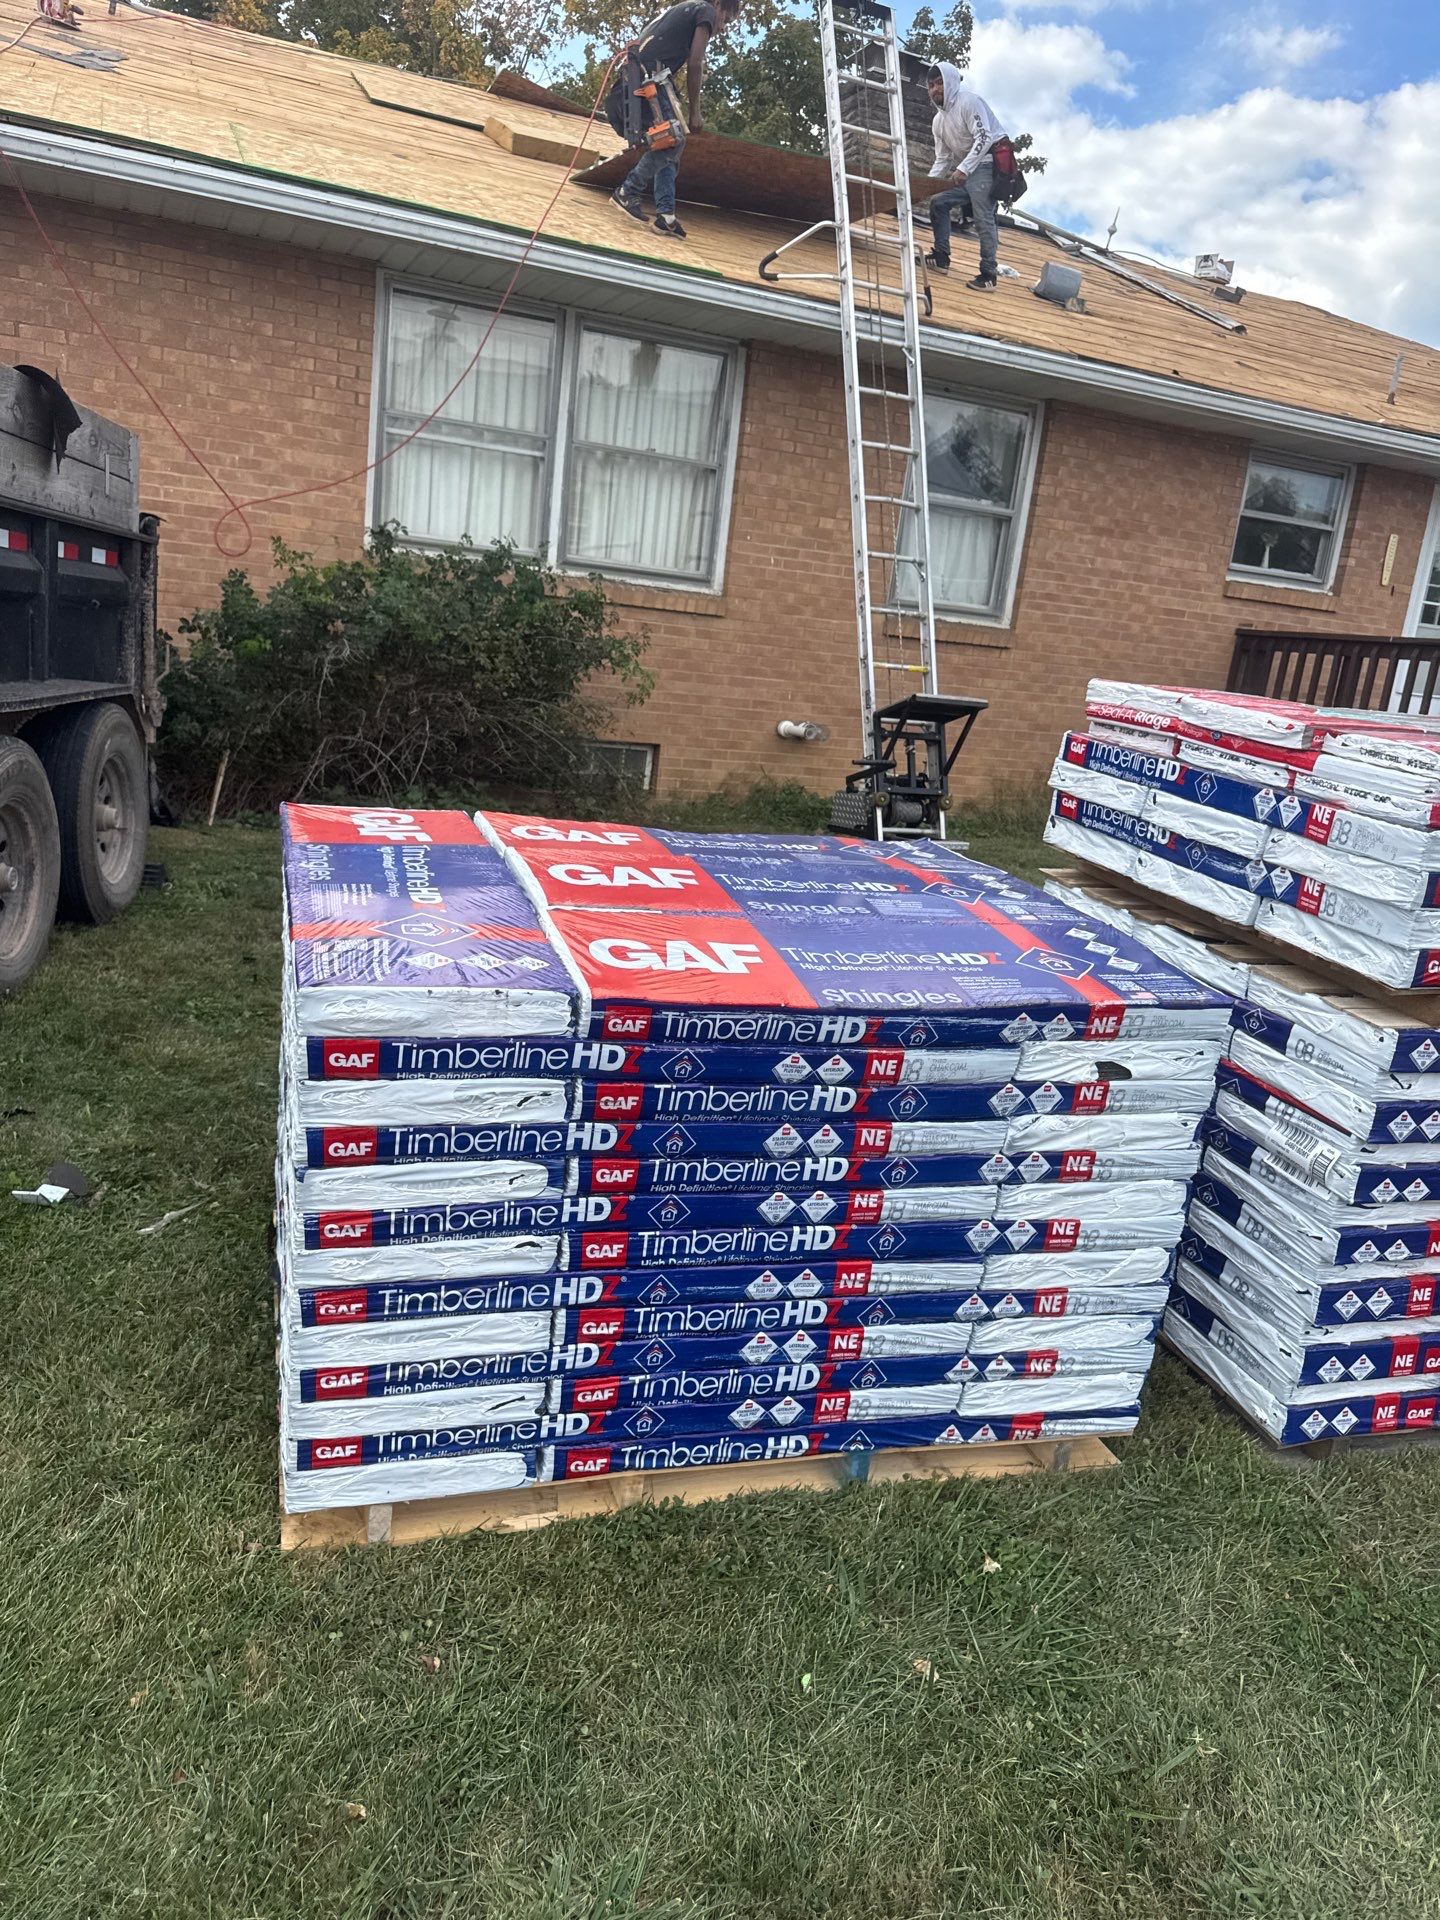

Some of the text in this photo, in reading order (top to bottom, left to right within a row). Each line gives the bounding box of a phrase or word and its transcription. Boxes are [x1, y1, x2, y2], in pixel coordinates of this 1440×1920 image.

[1070, 740, 1088, 757] GAF
[1359, 747, 1401, 764] CHARCOAL
[1344, 785, 1370, 799] RIDGE
[1062, 797, 1077, 810] GAF
[1312, 805, 1332, 825] NE
[350, 812, 433, 842] GAF
[1330, 817, 1353, 846] 08
[511, 824, 641, 846] GAF
[547, 863, 699, 890] GAF
[1304, 878, 1322, 897] NE
[747, 901, 871, 915] Shingles
[589, 938, 763, 974] GAF
[800, 962, 829, 972] High
[832, 964, 888, 972] Definition
[822, 988, 962, 1006] Shingles
[607, 1019, 646, 1033] GAF
[1091, 1016, 1117, 1034] NE
[1295, 1038, 1315, 1063] 08
[329, 1052, 375, 1068] GAF
[871, 1059, 898, 1076] NE
[1079, 1085, 1104, 1101] NE
[600, 1096, 639, 1110] GAF
[860, 1130, 886, 1147] NE
[328, 1142, 373, 1157] GAF
[1066, 1156, 1090, 1171] NE
[596, 1168, 635, 1182] GAF
[650, 1184, 675, 1192] High
[679, 1184, 729, 1192] Definition
[854, 1193, 878, 1209] NE
[324, 1224, 368, 1239] GAF
[1052, 1221, 1075, 1236] NE
[1244, 1217, 1264, 1240] 08
[585, 1245, 624, 1259] GAF
[839, 1273, 867, 1289] NE
[1413, 1288, 1432, 1302] NE
[320, 1303, 363, 1316] GAF
[1039, 1296, 1062, 1313] NE
[582, 1322, 618, 1335] GAF
[834, 1334, 859, 1350] NE
[1030, 1358, 1052, 1373] NE
[1394, 1354, 1414, 1368] NE
[320, 1374, 364, 1388] GAF
[384, 1384, 411, 1395] High
[578, 1388, 615, 1402] GAF
[820, 1398, 845, 1412] NE
[1376, 1406, 1396, 1420] NE
[1408, 1408, 1433, 1419] GAF
[316, 1445, 358, 1459] GAF
[570, 1459, 607, 1473] GAF
